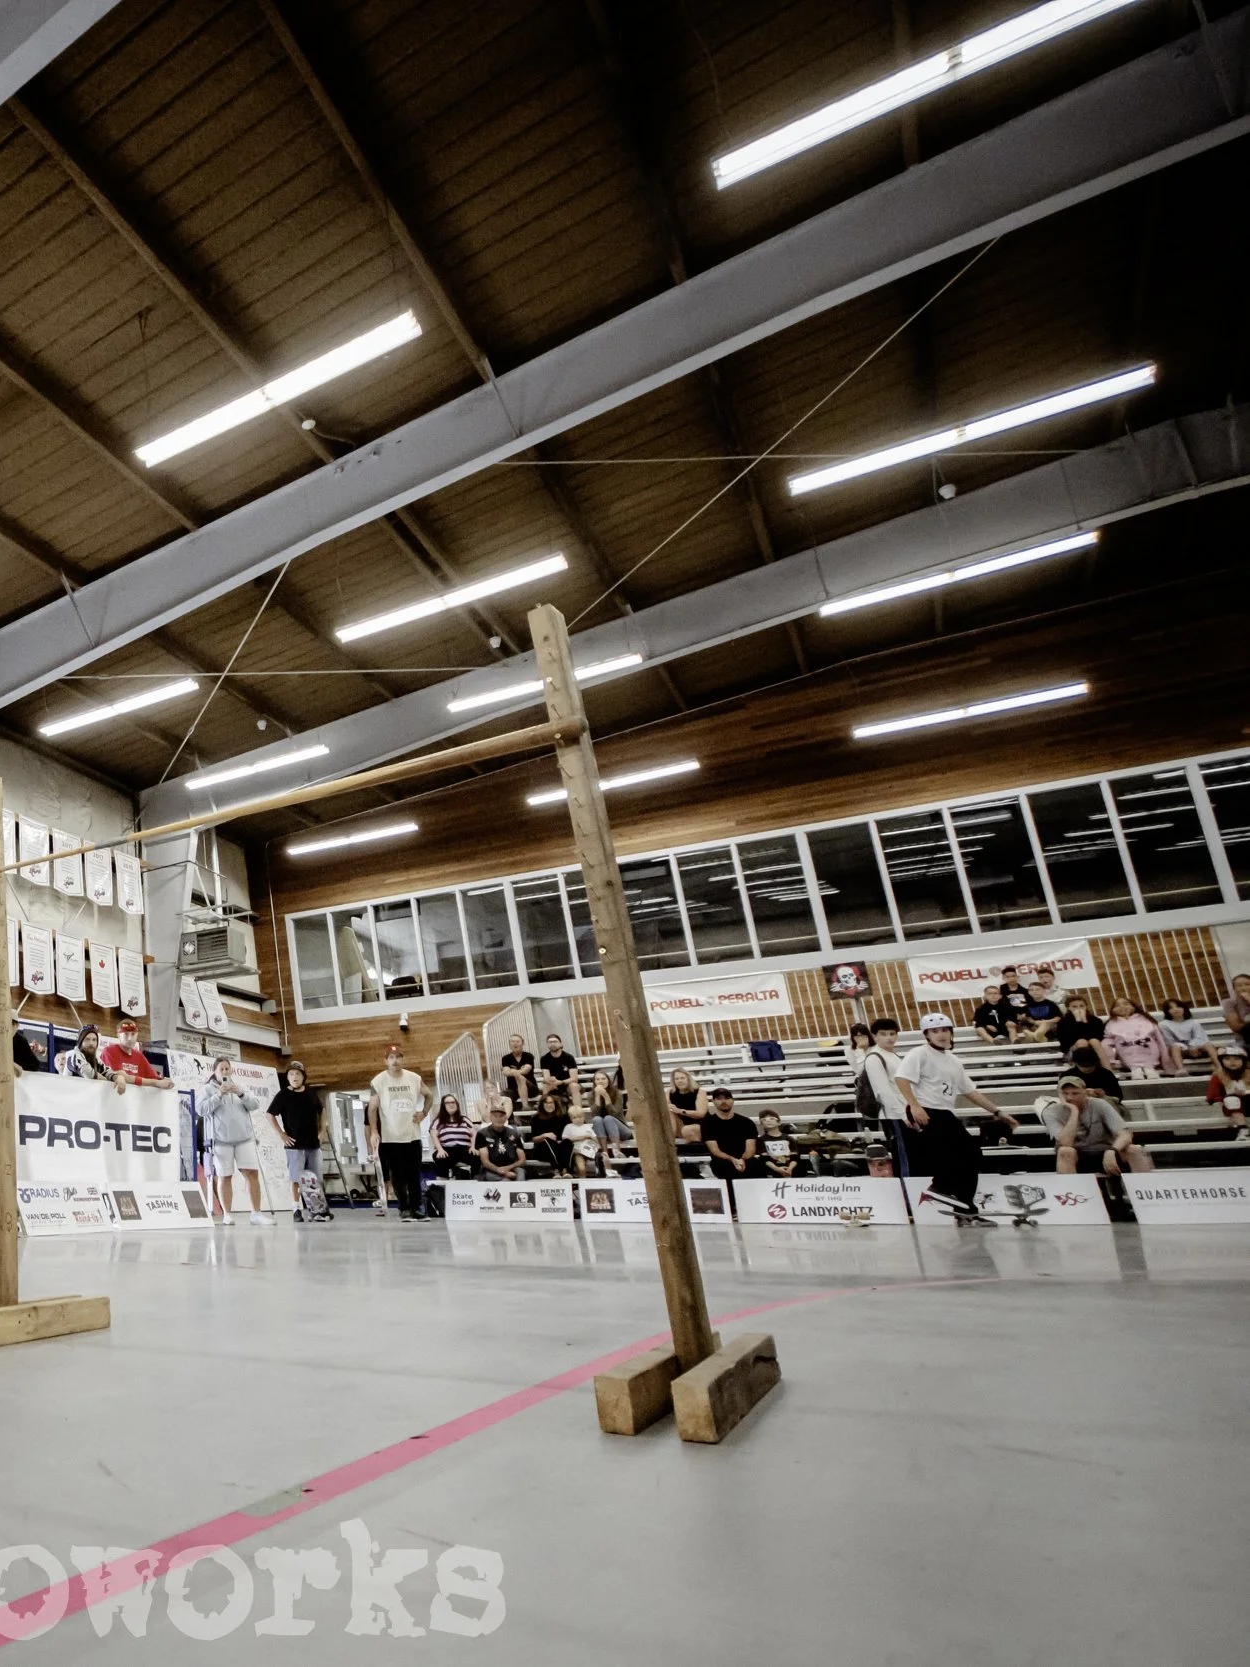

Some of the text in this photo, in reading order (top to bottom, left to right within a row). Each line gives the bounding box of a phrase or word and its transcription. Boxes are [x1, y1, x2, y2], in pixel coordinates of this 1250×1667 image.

[918, 968, 988, 985] POWELL
[651, 989, 780, 1011] POWELL PERALTA
[18, 1114, 172, 1154] PRO-TEC
[30, 1187, 60, 1198] RADIUS
[795, 1183, 861, 1195] Holiday Inn
[1135, 1187, 1247, 1201] QUARTERHORSE
[452, 1192, 473, 1200] Skate
[627, 1196, 648, 1207] TAS
[146, 1200, 179, 1211] TASHME
